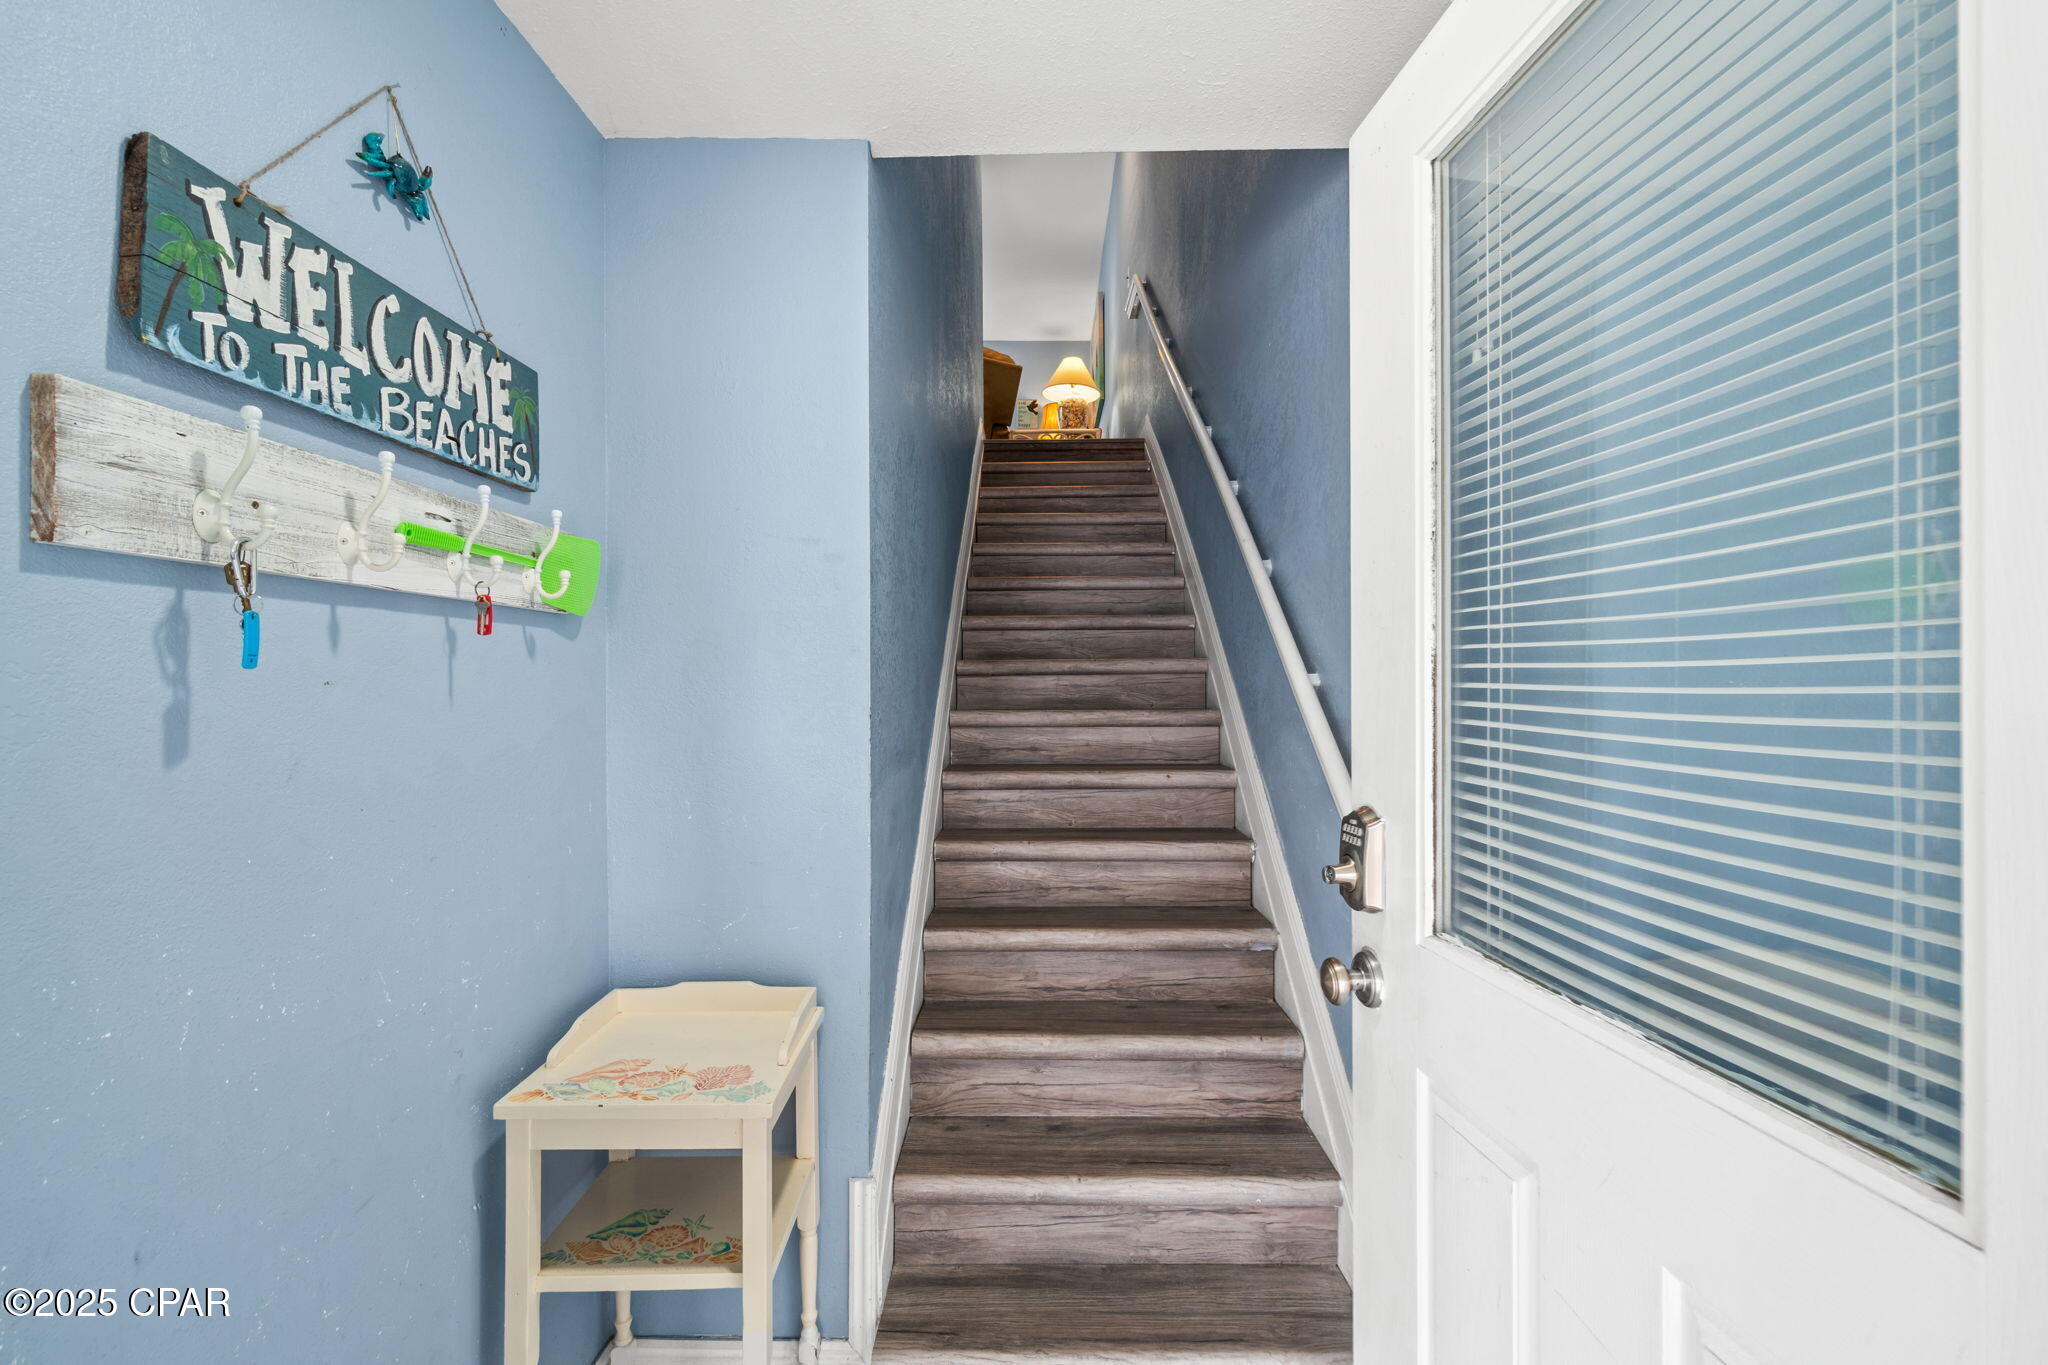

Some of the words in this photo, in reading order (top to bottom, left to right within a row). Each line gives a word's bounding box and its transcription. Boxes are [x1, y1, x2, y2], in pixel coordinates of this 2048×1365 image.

[188, 182, 514, 434] WELCOME
[191, 310, 251, 372] TO
[273, 342, 352, 413] THE
[379, 386, 532, 482] BEACHES
